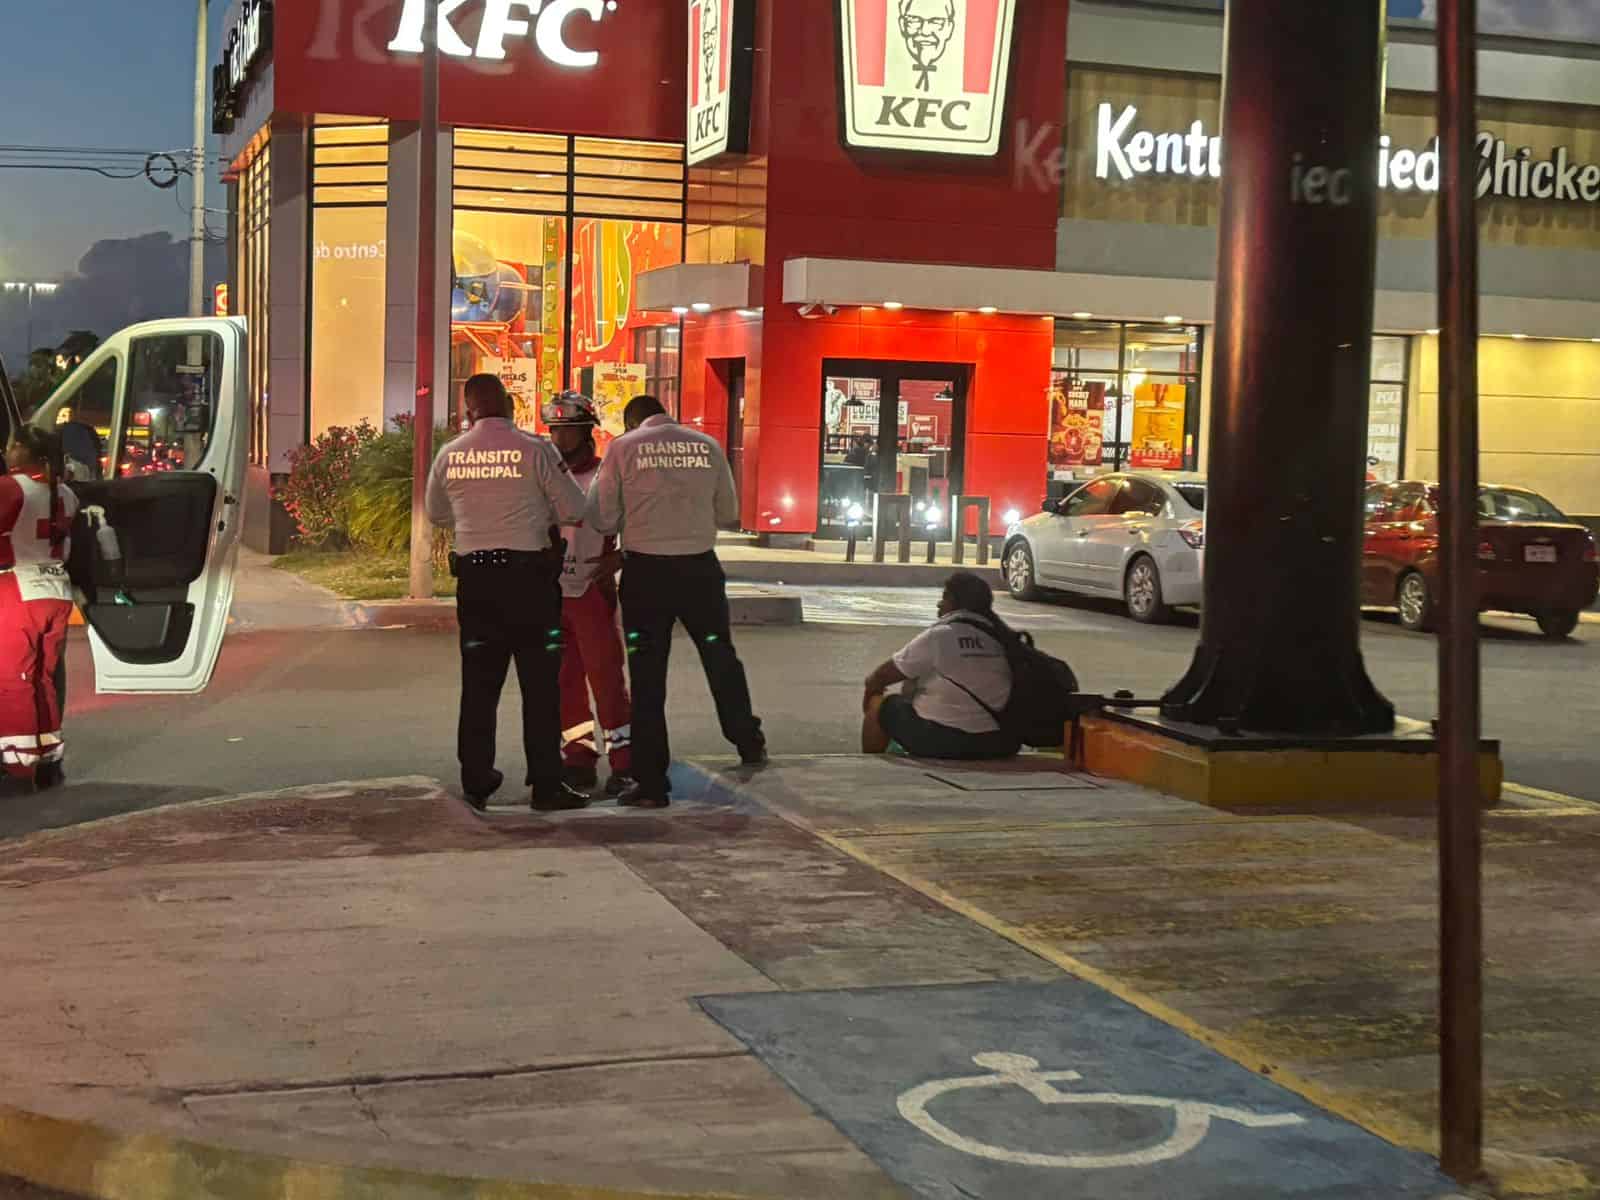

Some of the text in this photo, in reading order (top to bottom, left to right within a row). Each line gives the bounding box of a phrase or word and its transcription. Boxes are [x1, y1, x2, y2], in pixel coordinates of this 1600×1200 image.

[387, 0, 604, 67] KFC
[694, 102, 721, 142] KFC
[875, 96, 971, 131] KFC
[447, 448, 522, 464] TRÁNSITO
[636, 456, 712, 470] MUNICIPAL
[446, 465, 522, 480] MUNICIPAL
